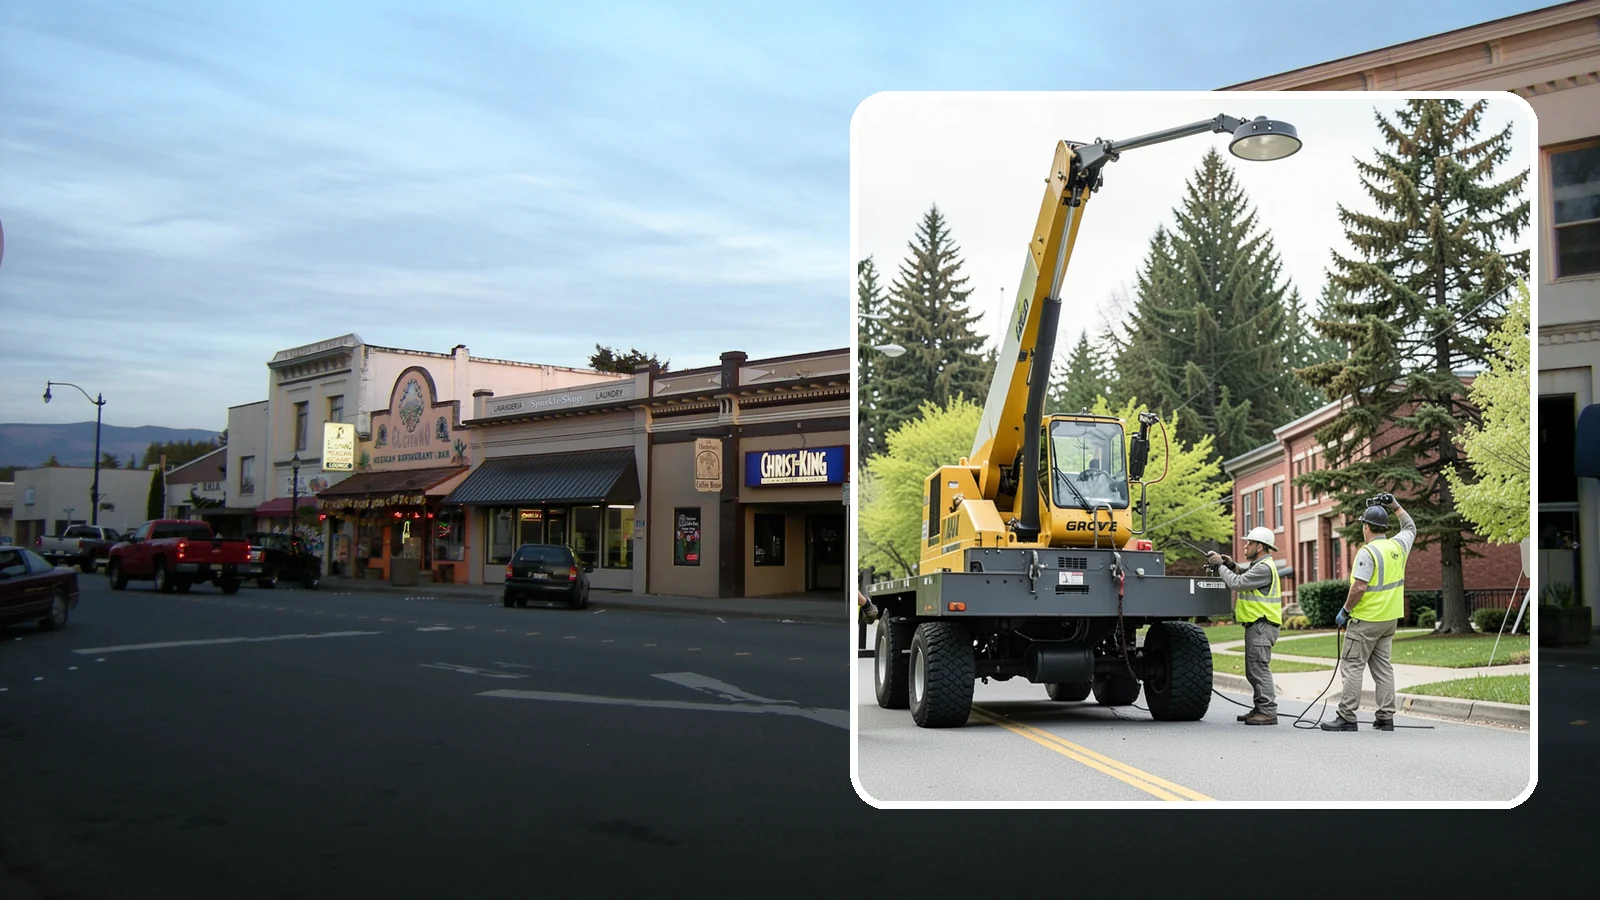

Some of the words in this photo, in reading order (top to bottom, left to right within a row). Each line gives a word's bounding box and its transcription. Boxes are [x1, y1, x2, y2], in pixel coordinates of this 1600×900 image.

[493, 402, 522, 412] LAVANDERIA
[531, 397, 561, 408] Sparkle
[562, 395, 581, 404] Shop
[596, 389, 623, 399] LAUNDRY
[392, 425, 402, 448] EL
[373, 455, 396, 463] MEXICAN
[397, 452, 433, 461] RESTAURANT
[761, 452, 797, 478] CHRIST
[799, 450, 827, 476] KING
[1066, 520, 1117, 532] GROVE
